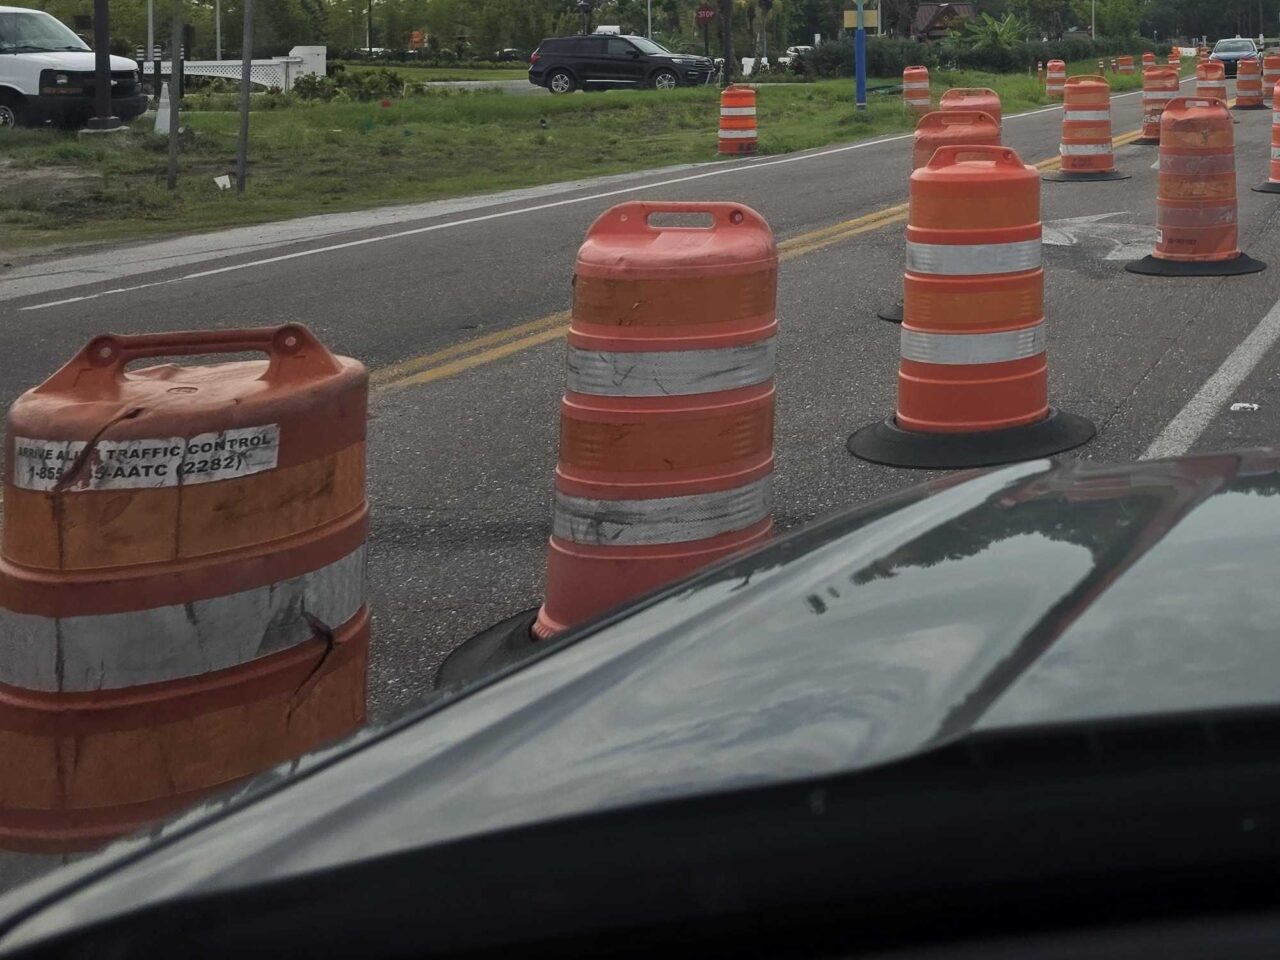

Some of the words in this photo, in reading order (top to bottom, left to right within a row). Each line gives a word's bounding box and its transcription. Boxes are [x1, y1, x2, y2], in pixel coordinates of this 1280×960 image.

[106, 446, 182, 460] TRAFFIC
[187, 434, 272, 455] CONTROL
[175, 453, 243, 478] (2282)
